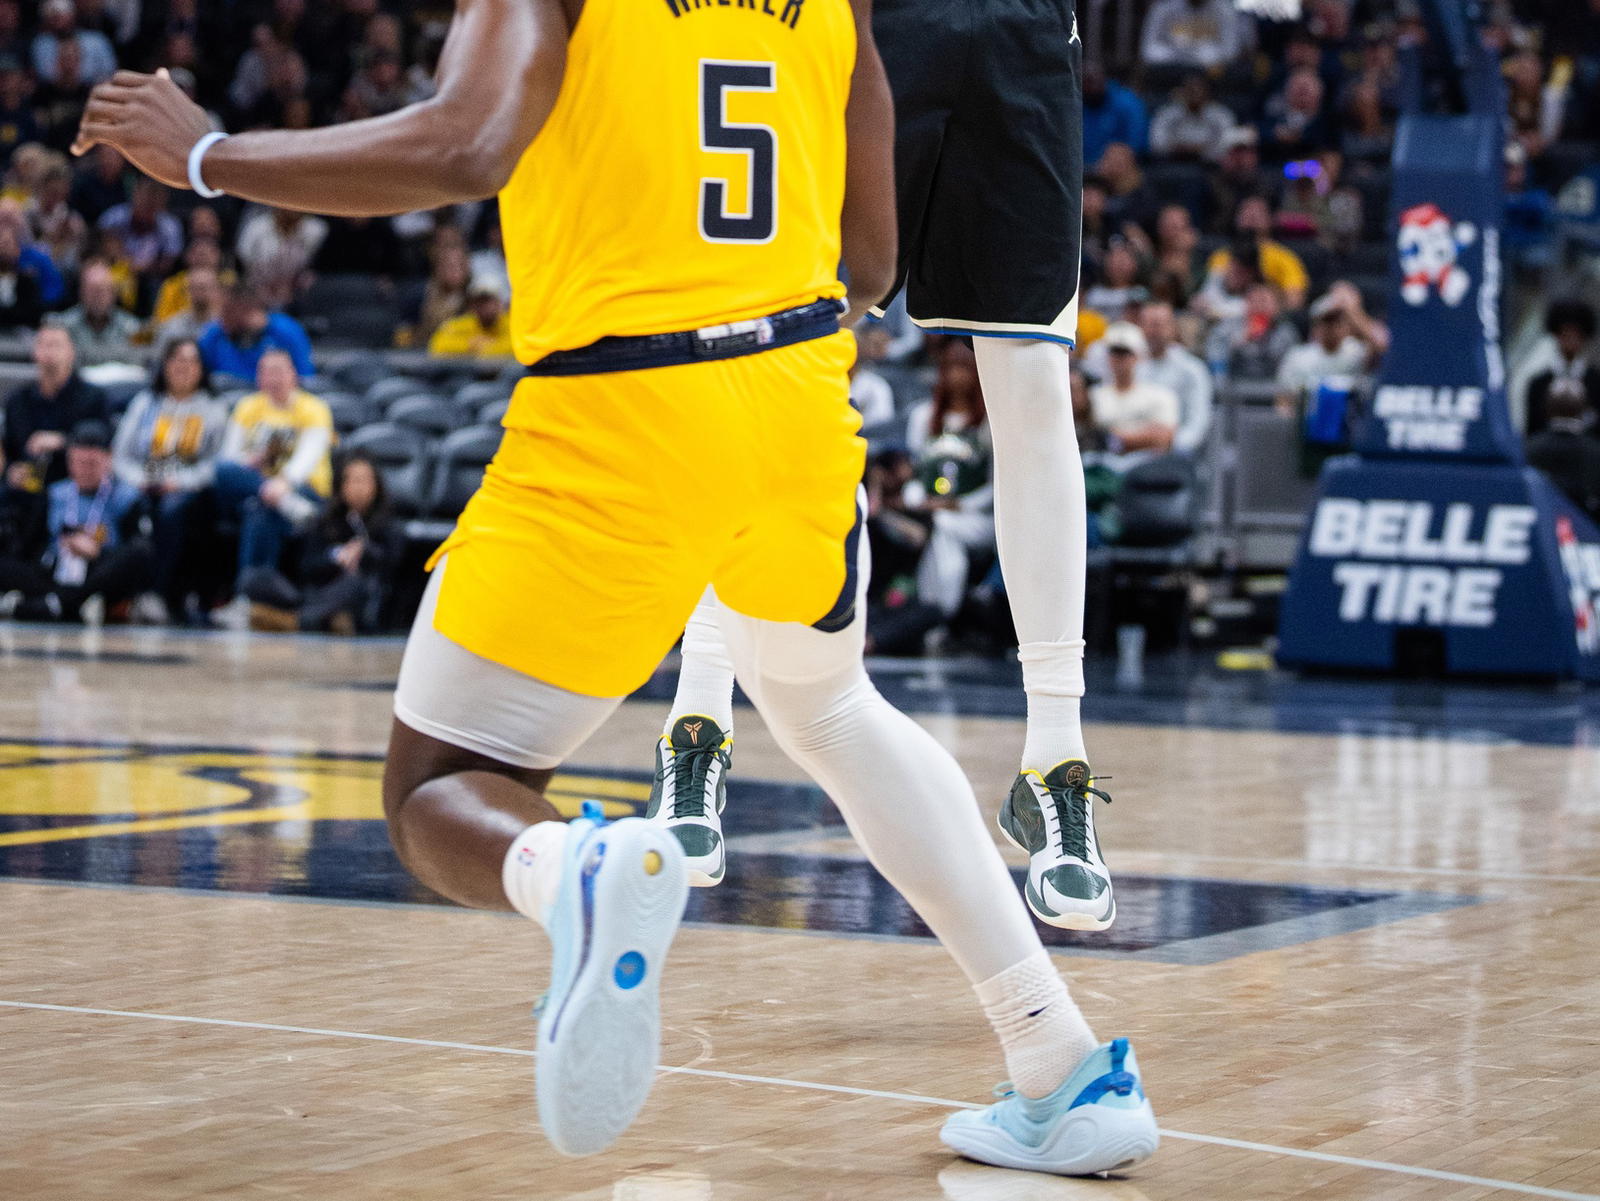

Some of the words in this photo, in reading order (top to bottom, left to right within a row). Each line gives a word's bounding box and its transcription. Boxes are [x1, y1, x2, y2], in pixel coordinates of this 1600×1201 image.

[698, 58, 777, 244] 5
[1309, 499, 1537, 564] BELLE
[1333, 563, 1502, 627] TIRE
